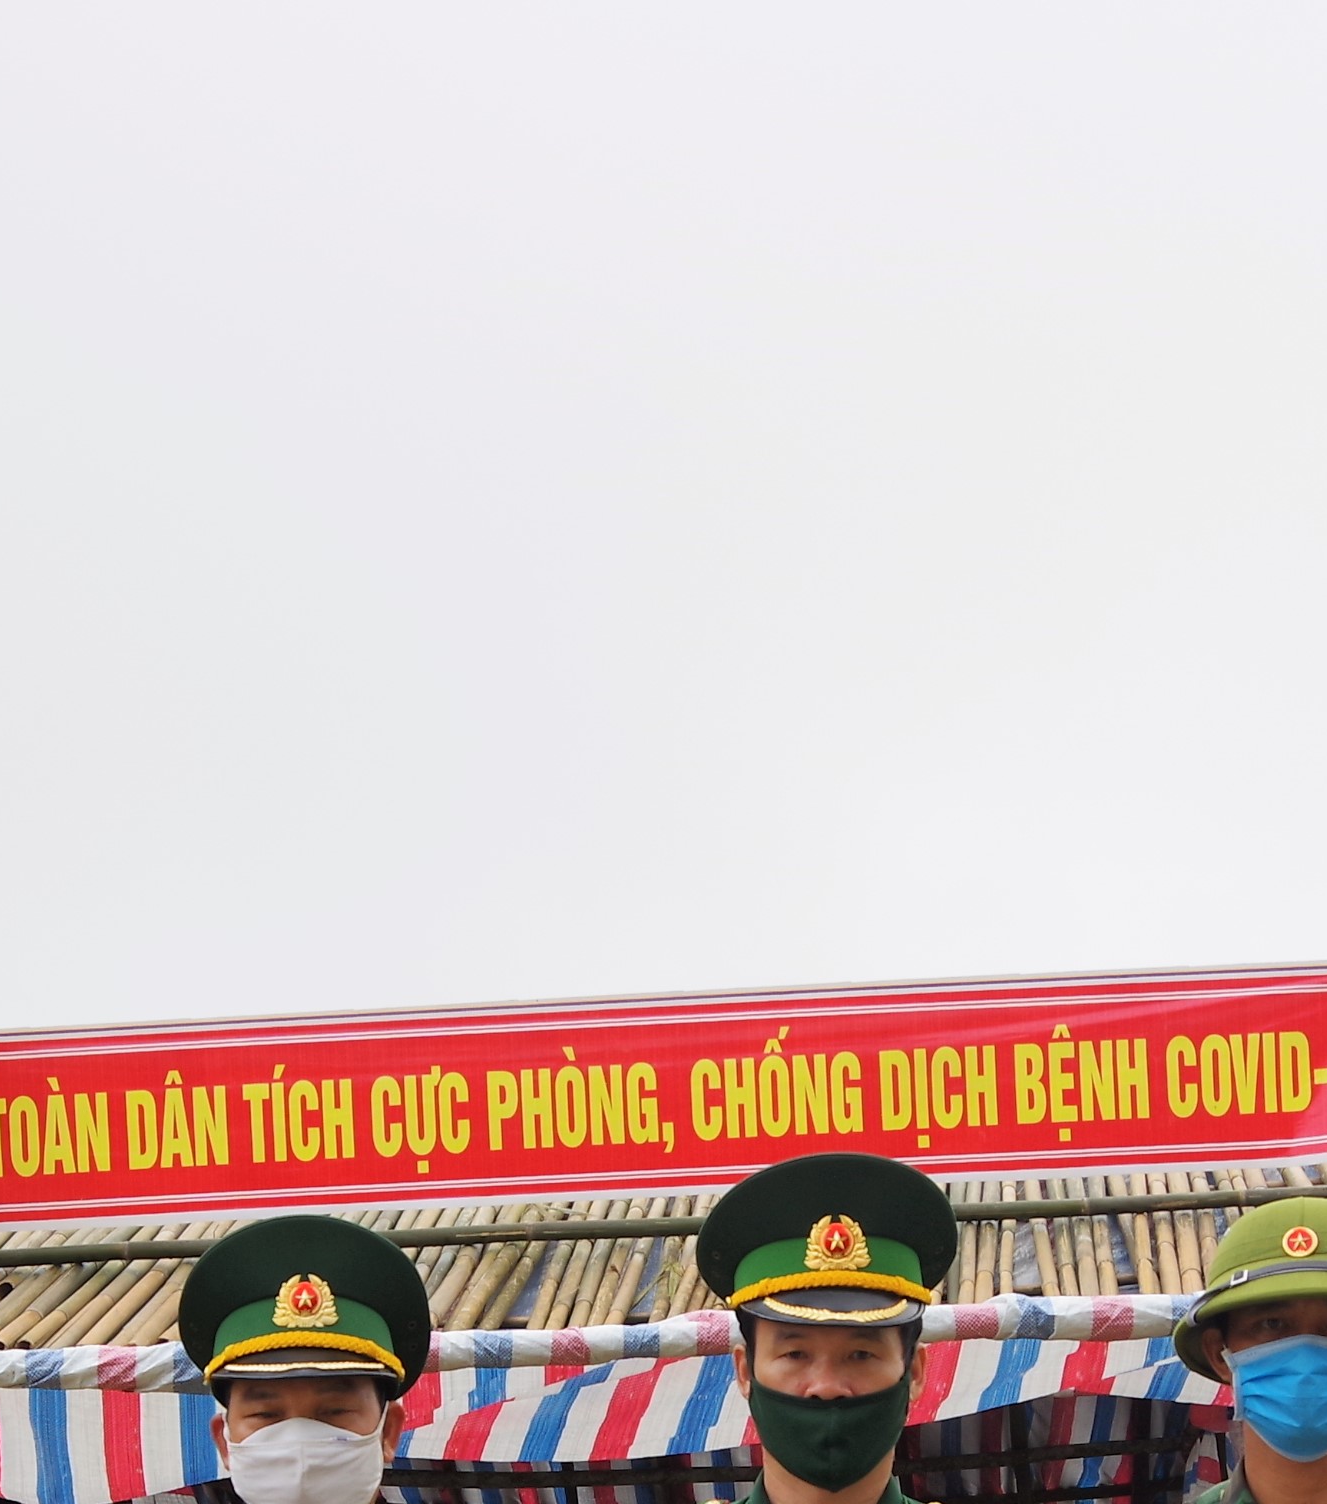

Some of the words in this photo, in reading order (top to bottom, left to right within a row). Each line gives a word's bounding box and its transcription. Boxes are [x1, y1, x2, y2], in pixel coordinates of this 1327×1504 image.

[125, 1069, 230, 1171] DÂN
[243, 1064, 356, 1164] TÍCH
[371, 1064, 471, 1174] CỰC
[487, 1046, 676, 1154] PHÒNG,
[689, 1025, 864, 1142] CHỐNG
[878, 1043, 998, 1149] DỊCH
[1013, 1024, 1150, 1142] BỆNH
